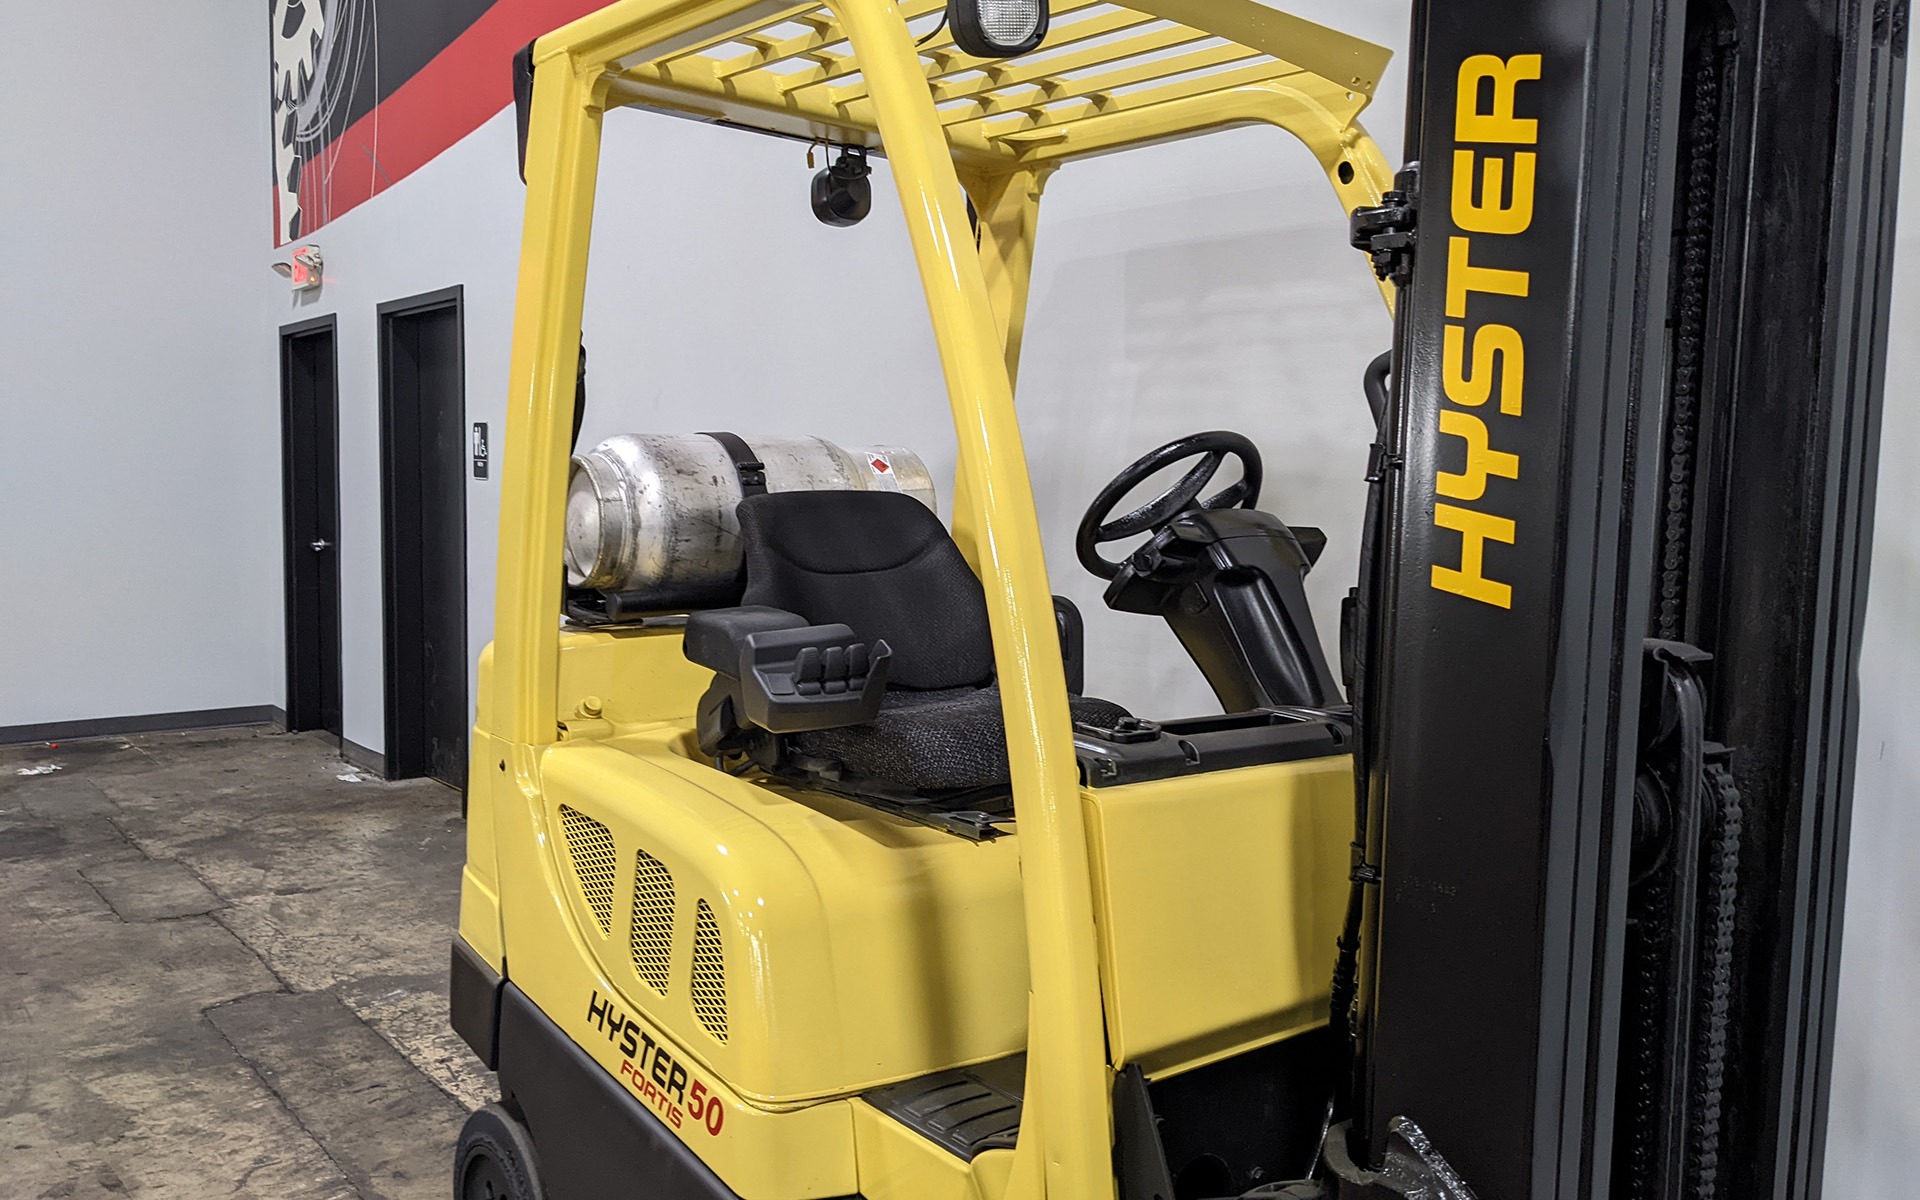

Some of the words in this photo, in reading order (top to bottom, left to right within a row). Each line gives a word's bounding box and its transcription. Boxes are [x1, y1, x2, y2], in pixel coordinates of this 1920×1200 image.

[1431, 54, 1542, 610] HYSTER
[587, 990, 688, 1106] HYSTER
[687, 1079, 724, 1136] 50
[620, 1059, 684, 1129] FORTIS
